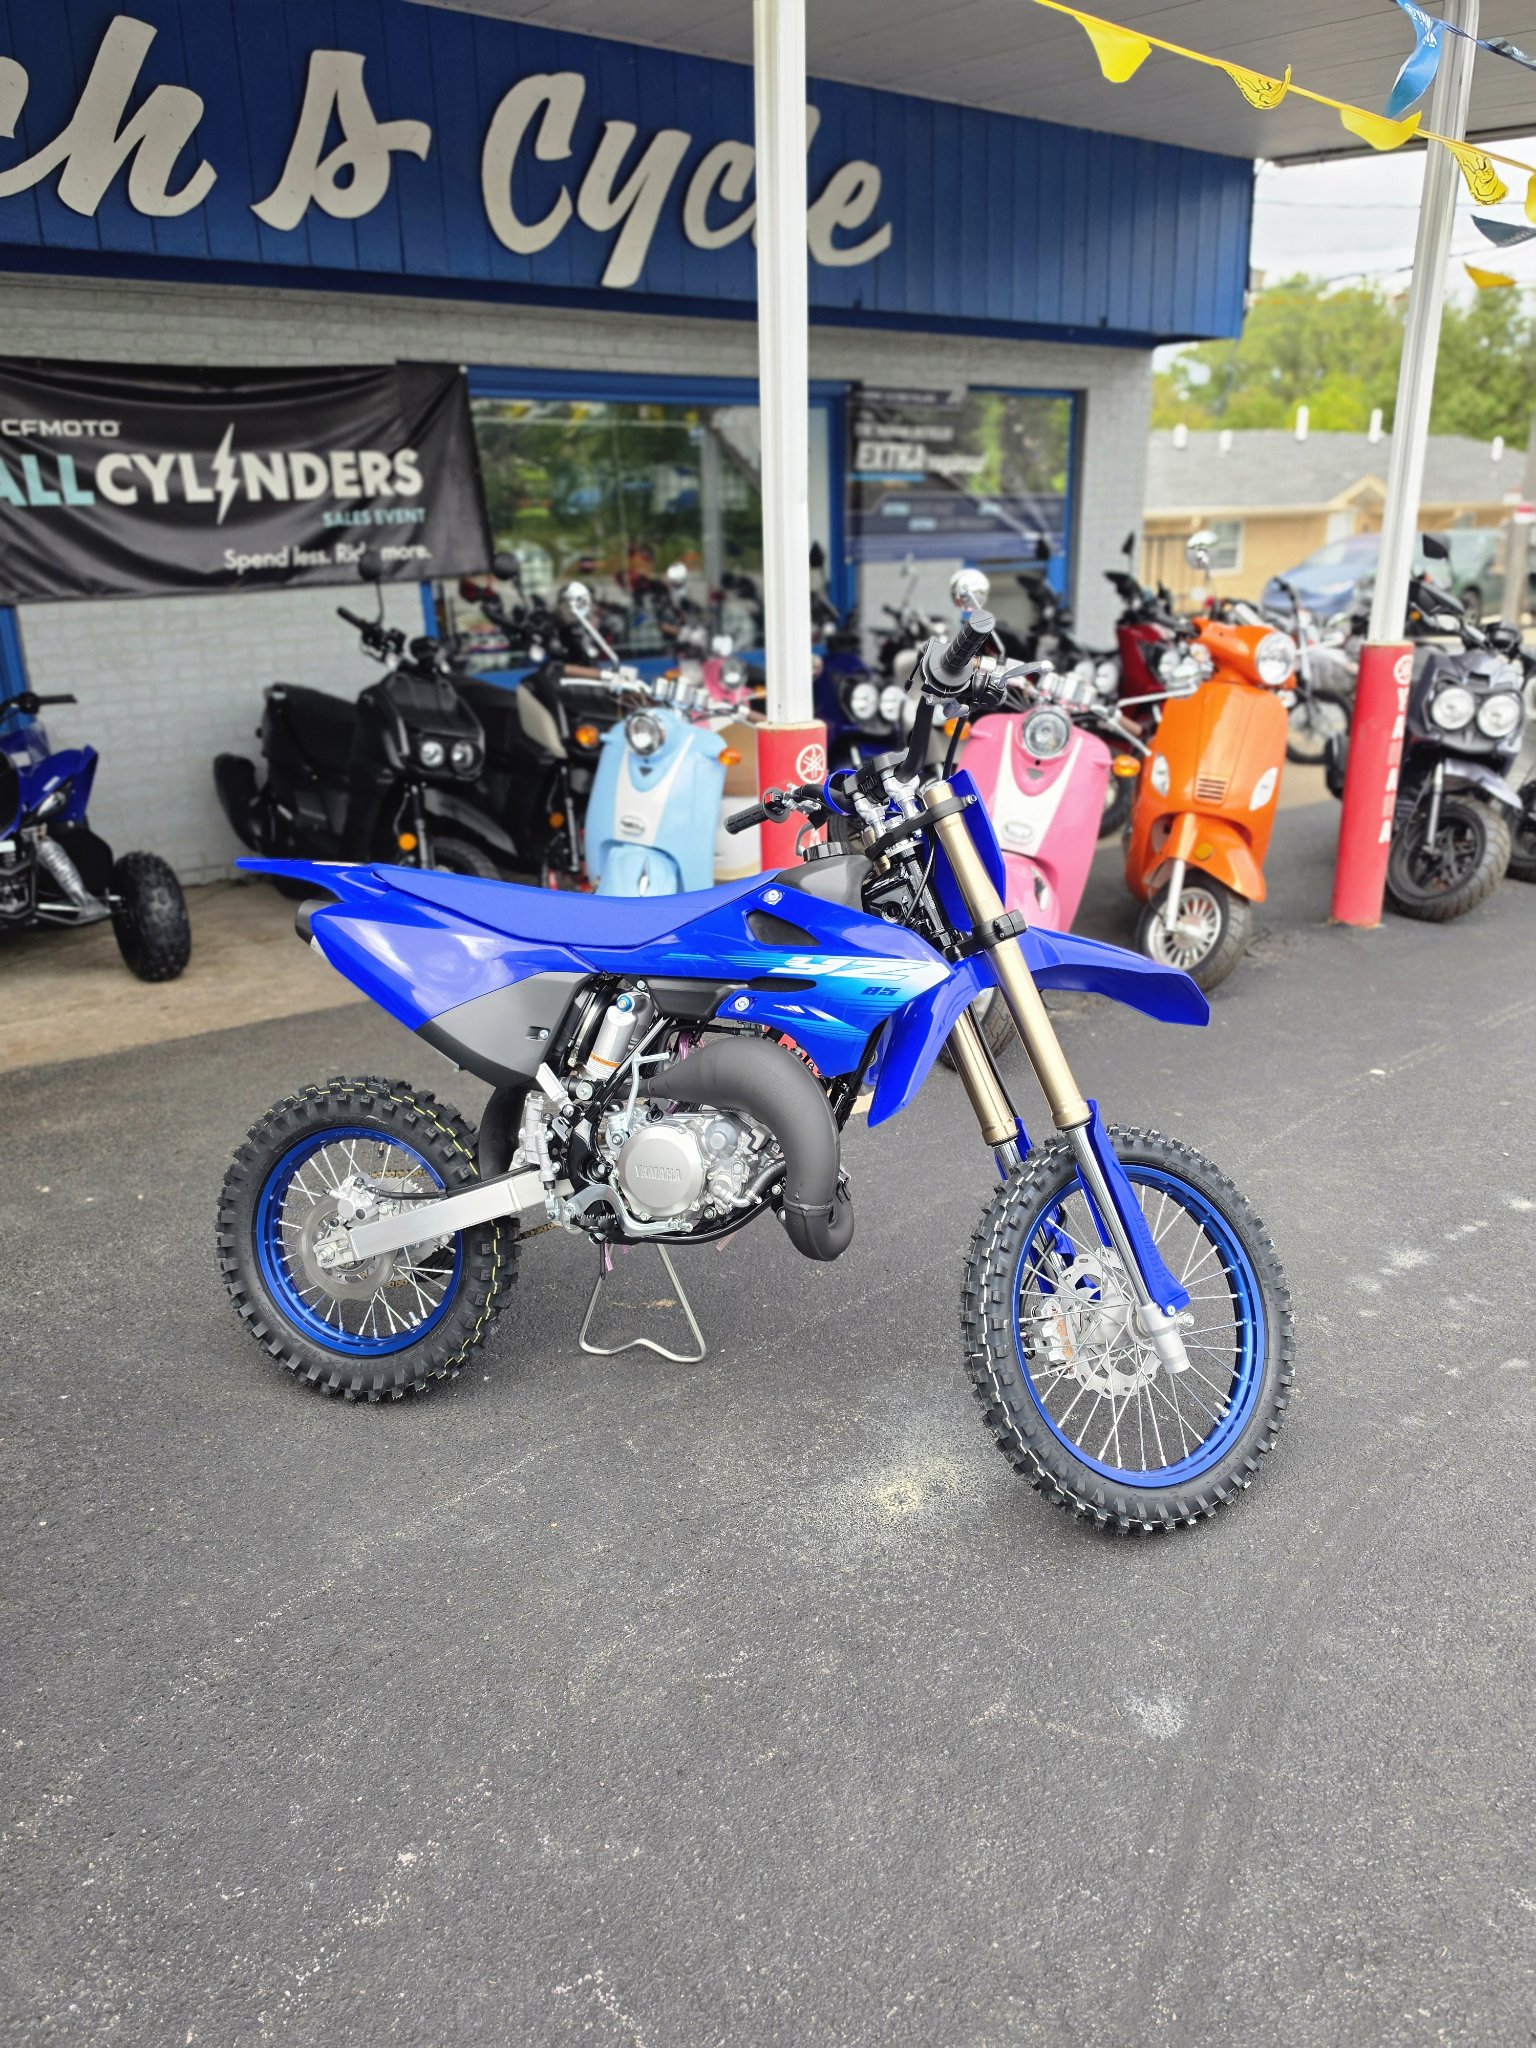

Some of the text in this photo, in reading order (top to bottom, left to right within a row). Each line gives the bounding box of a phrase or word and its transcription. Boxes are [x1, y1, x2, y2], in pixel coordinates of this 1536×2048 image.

[482, 71, 893, 287] Cyce
[1, 420, 120, 438] CFMOTO
[322, 507, 426, 528] SALES EVENT
[224, 547, 288, 574] Spend
[293, 546, 332, 565] less.
[767, 956, 930, 981] YZ
[861, 986, 902, 997] 85
[634, 1164, 682, 1182] YAMAHA
